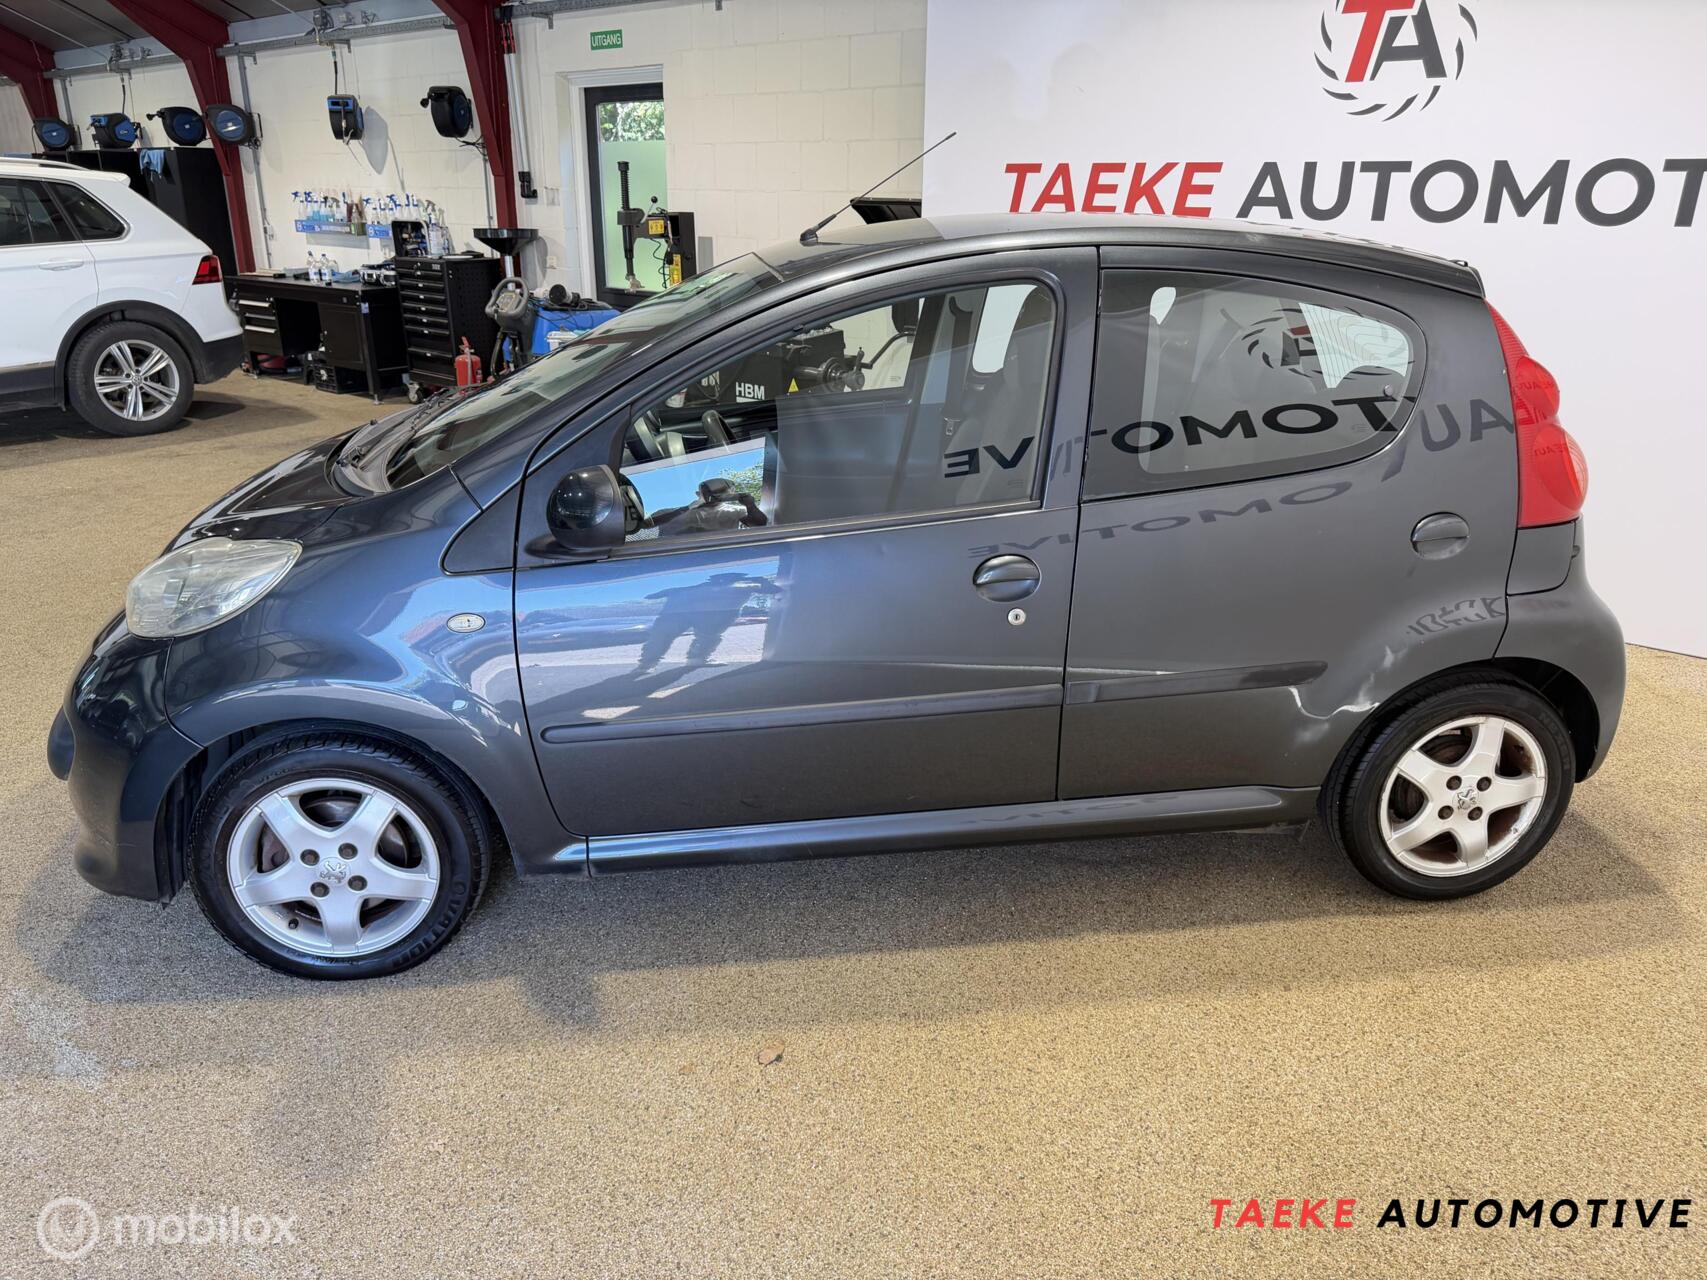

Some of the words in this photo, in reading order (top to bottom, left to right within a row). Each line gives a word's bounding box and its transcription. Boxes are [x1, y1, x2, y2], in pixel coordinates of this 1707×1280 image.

[591, 33, 621, 47] UITGANG
[1341, 0, 1447, 82] TA
[1004, 162, 1224, 217] TAEKE
[1235, 157, 1707, 228] AUTOMOT
[735, 381, 765, 400] HBM
